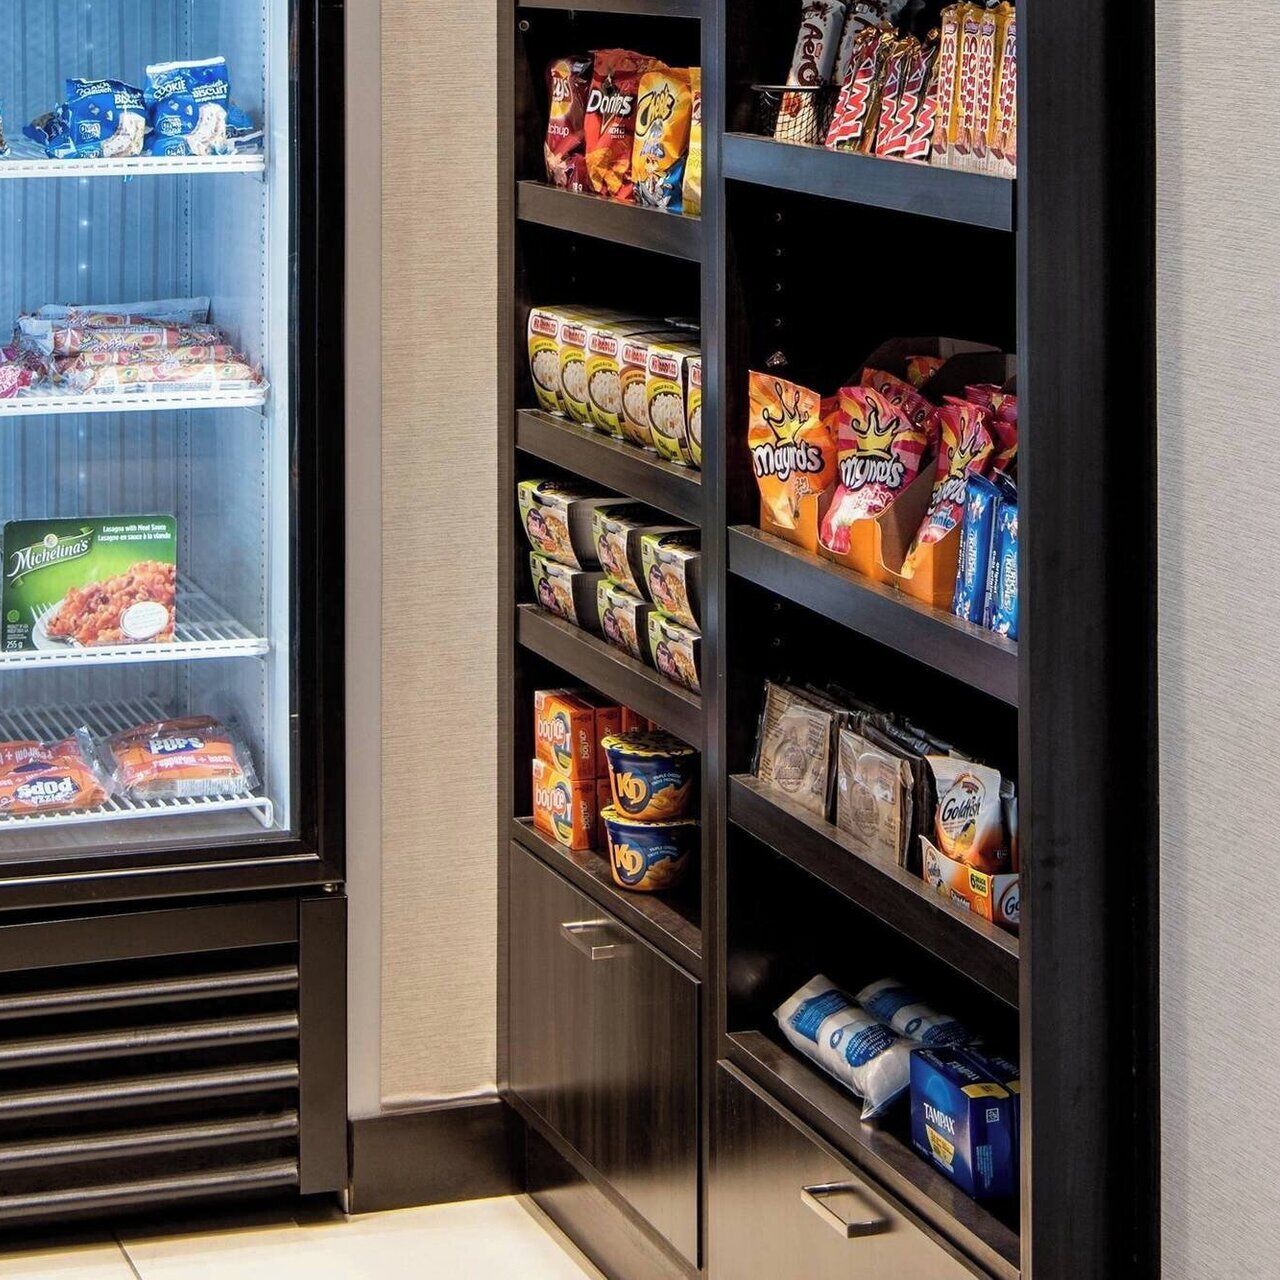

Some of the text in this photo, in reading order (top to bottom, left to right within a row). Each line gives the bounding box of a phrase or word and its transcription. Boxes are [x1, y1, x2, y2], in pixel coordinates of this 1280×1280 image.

[587, 90, 633, 115] Doritos
[7, 537, 91, 577] Michelina's
[537, 717, 566, 745] bounce
[149, 738, 204, 754] POPS
[15, 777, 72, 799] POPS
[617, 771, 647, 804] KD
[535, 788, 566, 815] bounce
[942, 796, 980, 822] Goldfish
[616, 843, 645, 875] KD
[923, 1102, 955, 1136] TAMPAX
